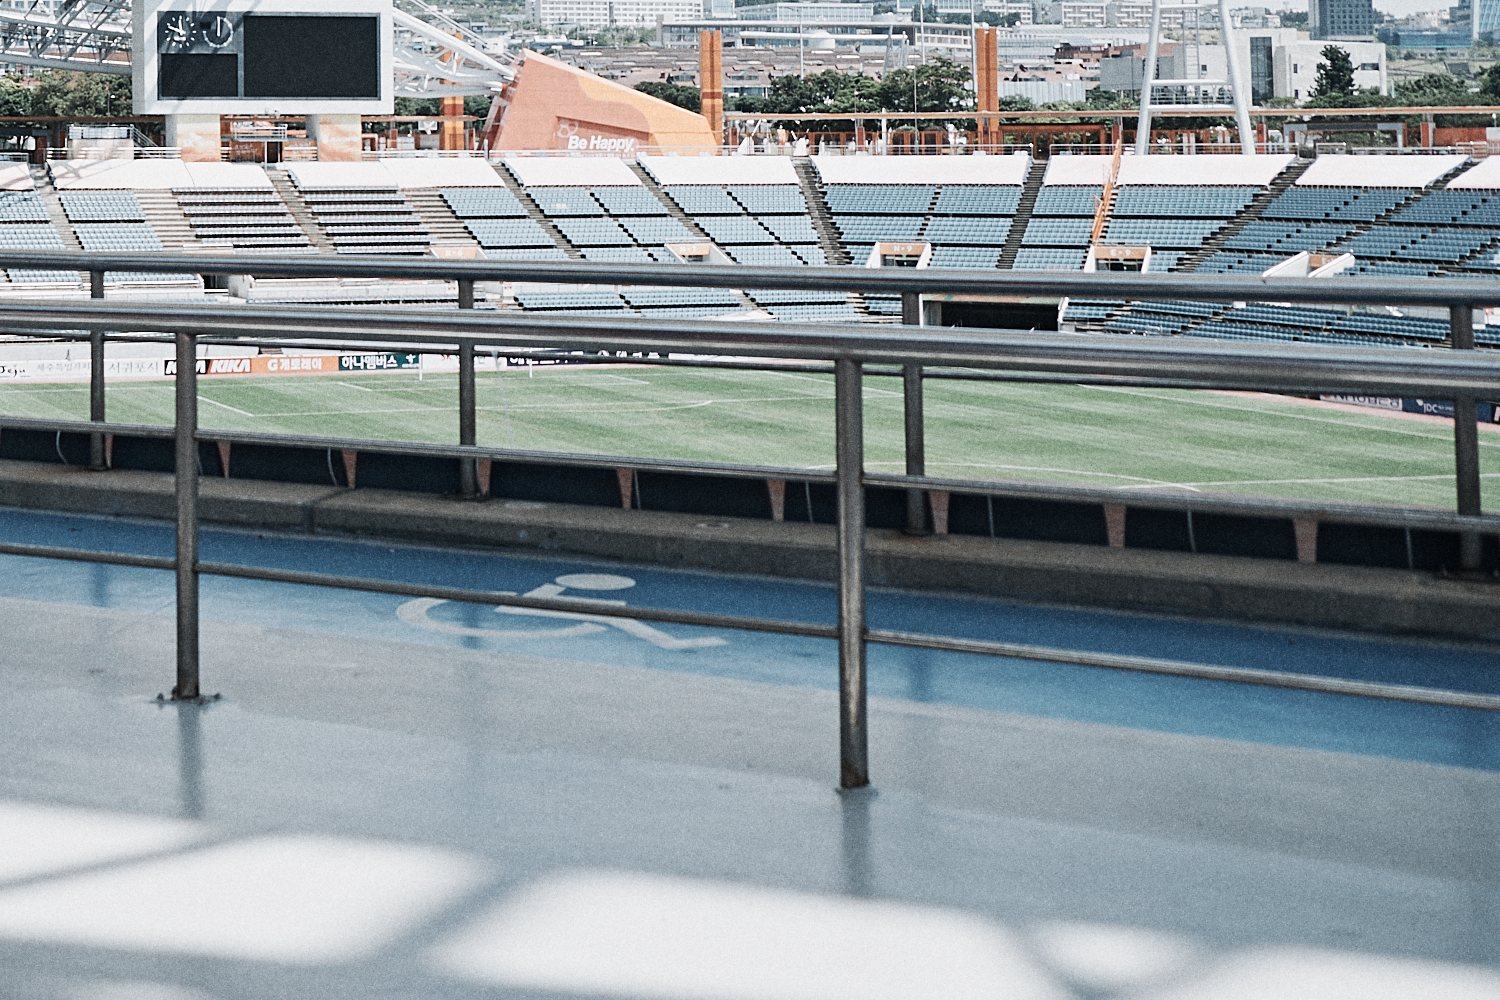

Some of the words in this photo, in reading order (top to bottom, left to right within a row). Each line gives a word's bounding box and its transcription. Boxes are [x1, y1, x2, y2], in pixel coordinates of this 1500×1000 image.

[568, 135, 588, 150] Be
[589, 135, 635, 153] Happy.
[210, 359, 251, 373] KIKA
[267, 358, 278, 371] G
[342, 354, 398, 370] 하나멤버스
[1423, 402, 1438, 414] JDC
